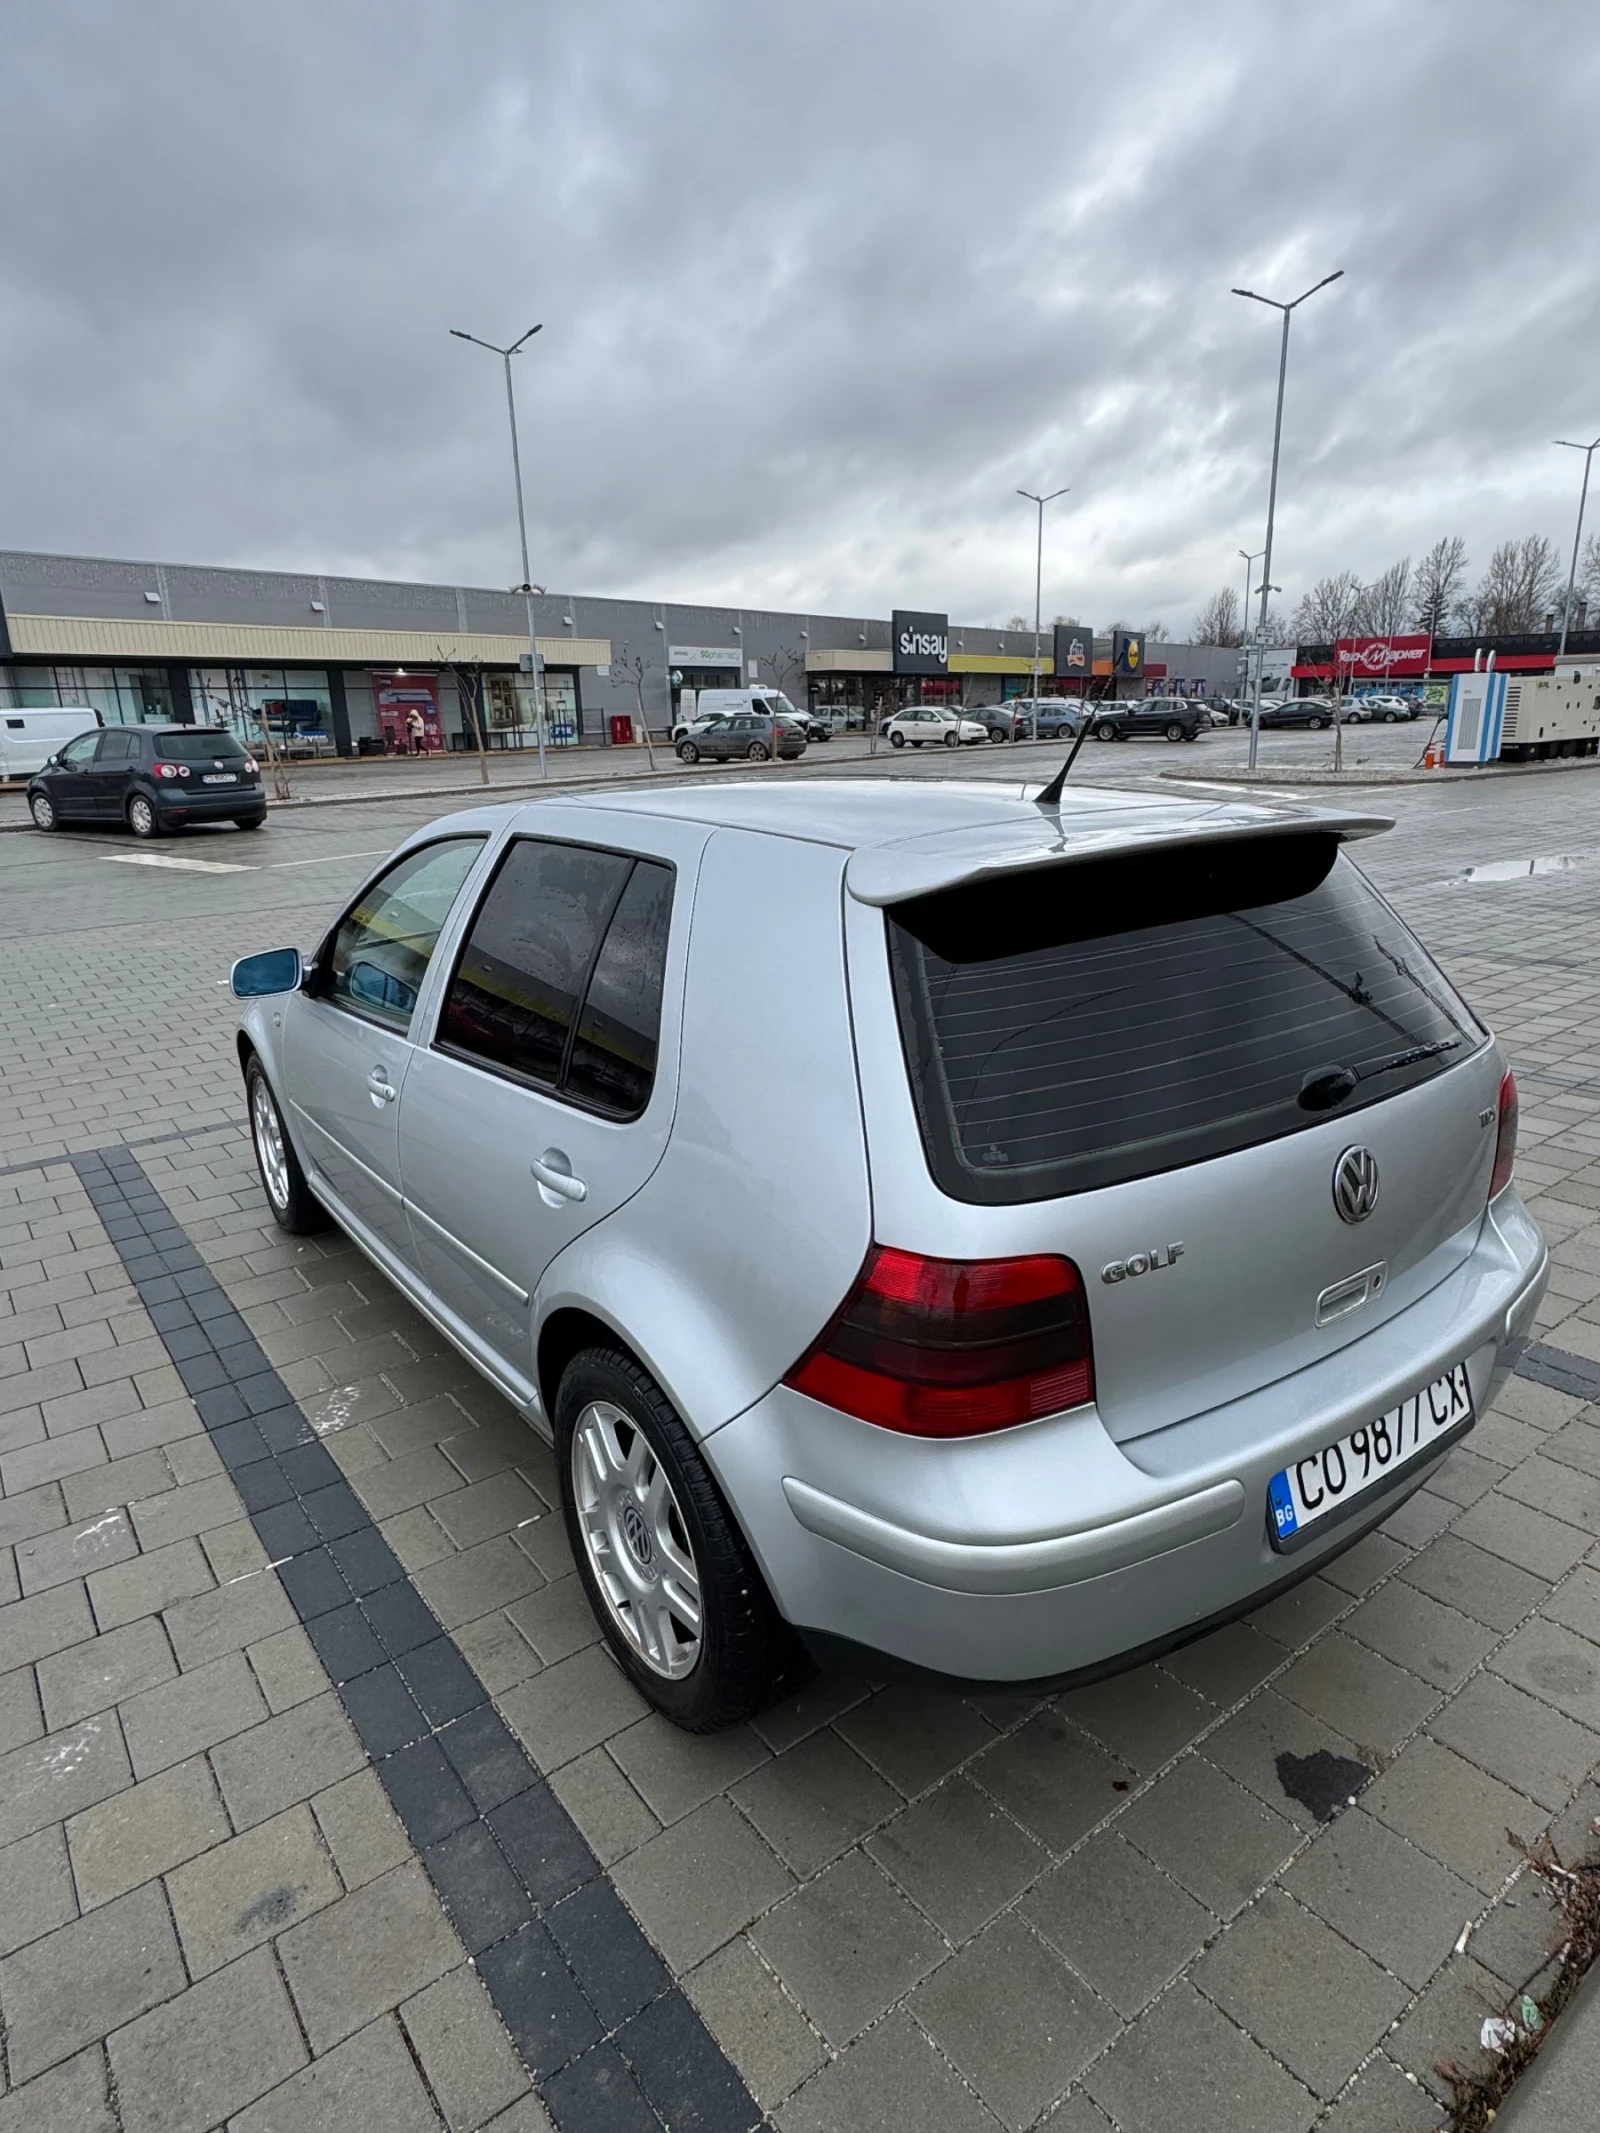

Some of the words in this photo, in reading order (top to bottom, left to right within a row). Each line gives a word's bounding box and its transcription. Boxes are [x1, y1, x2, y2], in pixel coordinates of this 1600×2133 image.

[900, 626, 948, 664] sinsay
[1101, 1240, 1185, 1285] GOLF
[1275, 1504, 1294, 1527] BG
